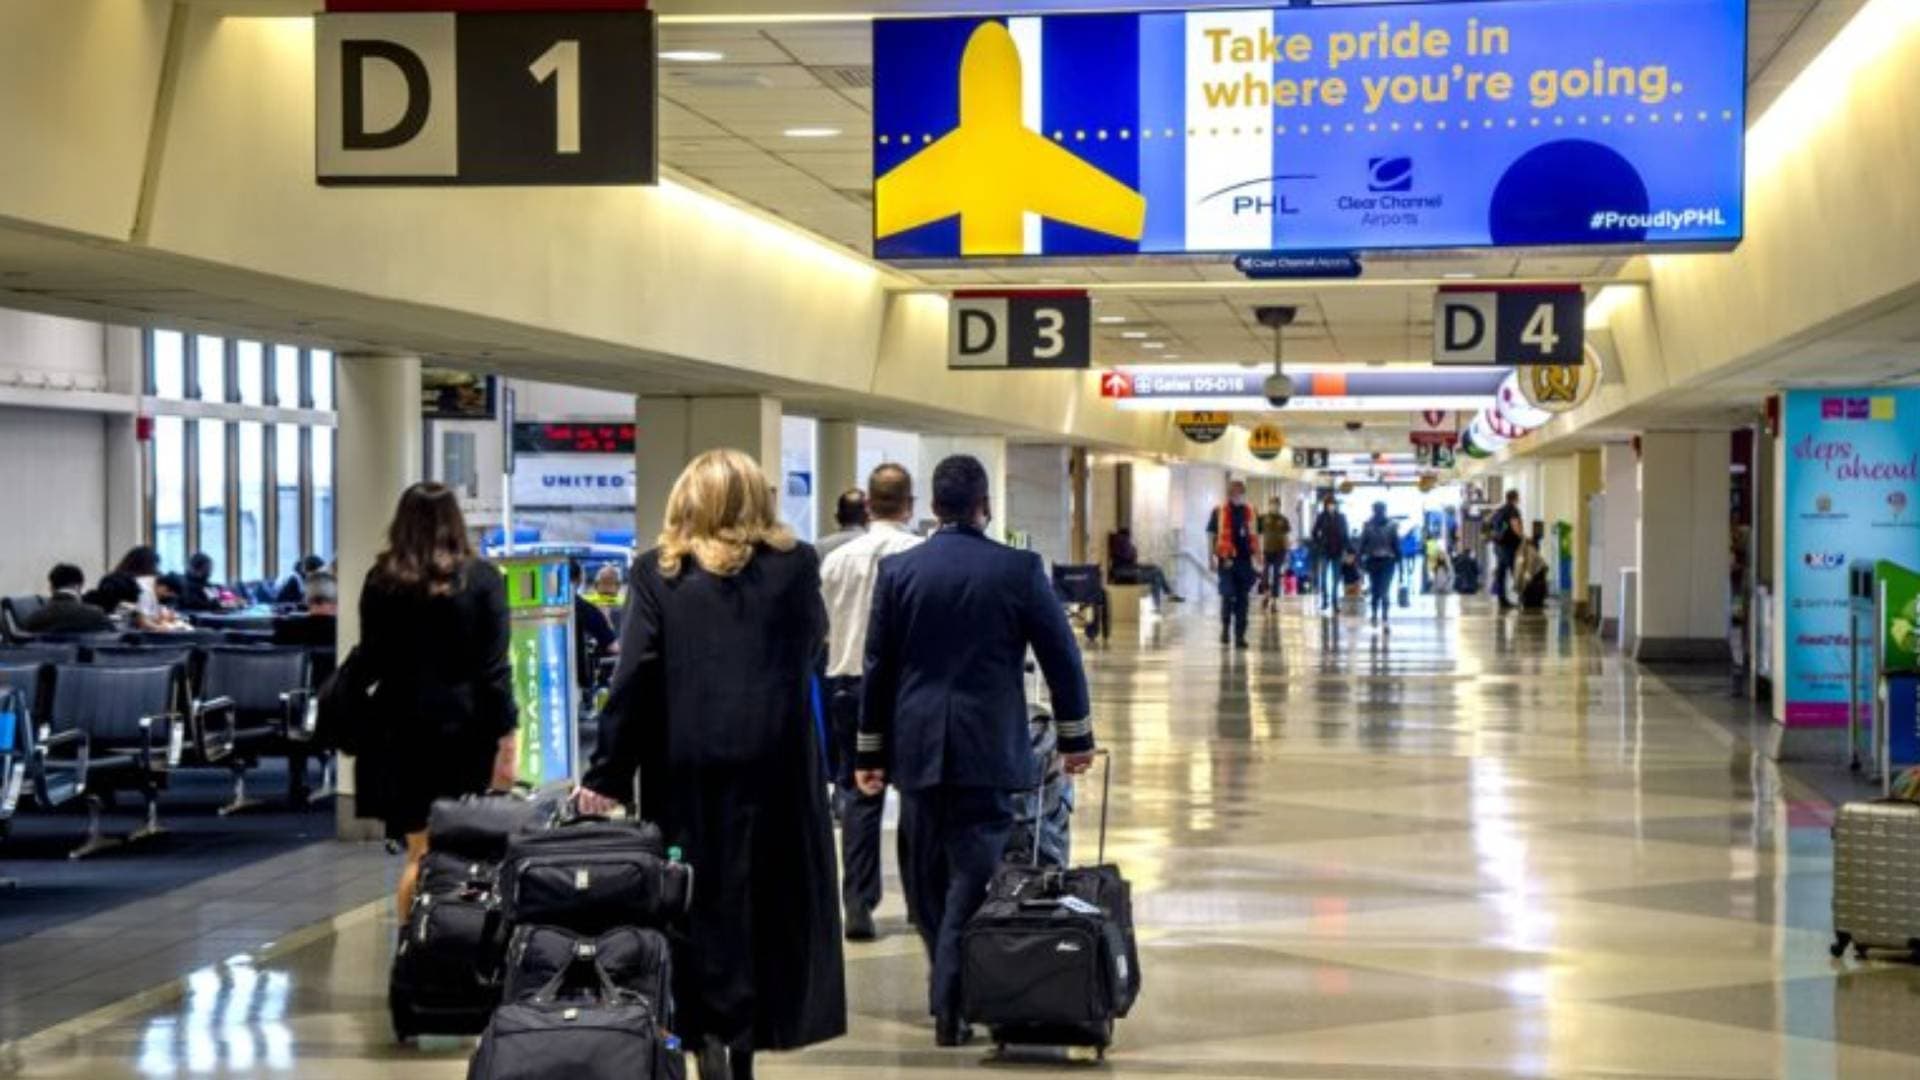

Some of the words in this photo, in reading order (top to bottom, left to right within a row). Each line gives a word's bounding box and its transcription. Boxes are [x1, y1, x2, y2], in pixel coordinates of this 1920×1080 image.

[1203, 27, 1313, 64] Take
[1328, 20, 1451, 70] pride
[1466, 17, 1509, 56] in
[341, 39, 432, 151] D
[528, 39, 581, 154] 1
[1203, 72, 1348, 109] where
[1528, 56, 1683, 108] going.
[1233, 196, 1300, 215] PHL
[1338, 195, 1376, 211] Clear
[1378, 193, 1444, 210] Channel
[1361, 211, 1418, 228] Airports
[1589, 207, 1726, 231] #ProudlyPHL
[959, 309, 997, 355] D
[1033, 308, 1065, 358] 3
[1445, 304, 1486, 351] D
[1520, 303, 1560, 354] 4
[542, 475, 625, 487] UNITED
[1836, 452, 1918, 481] ahead
[526, 639, 540, 775] recycle
